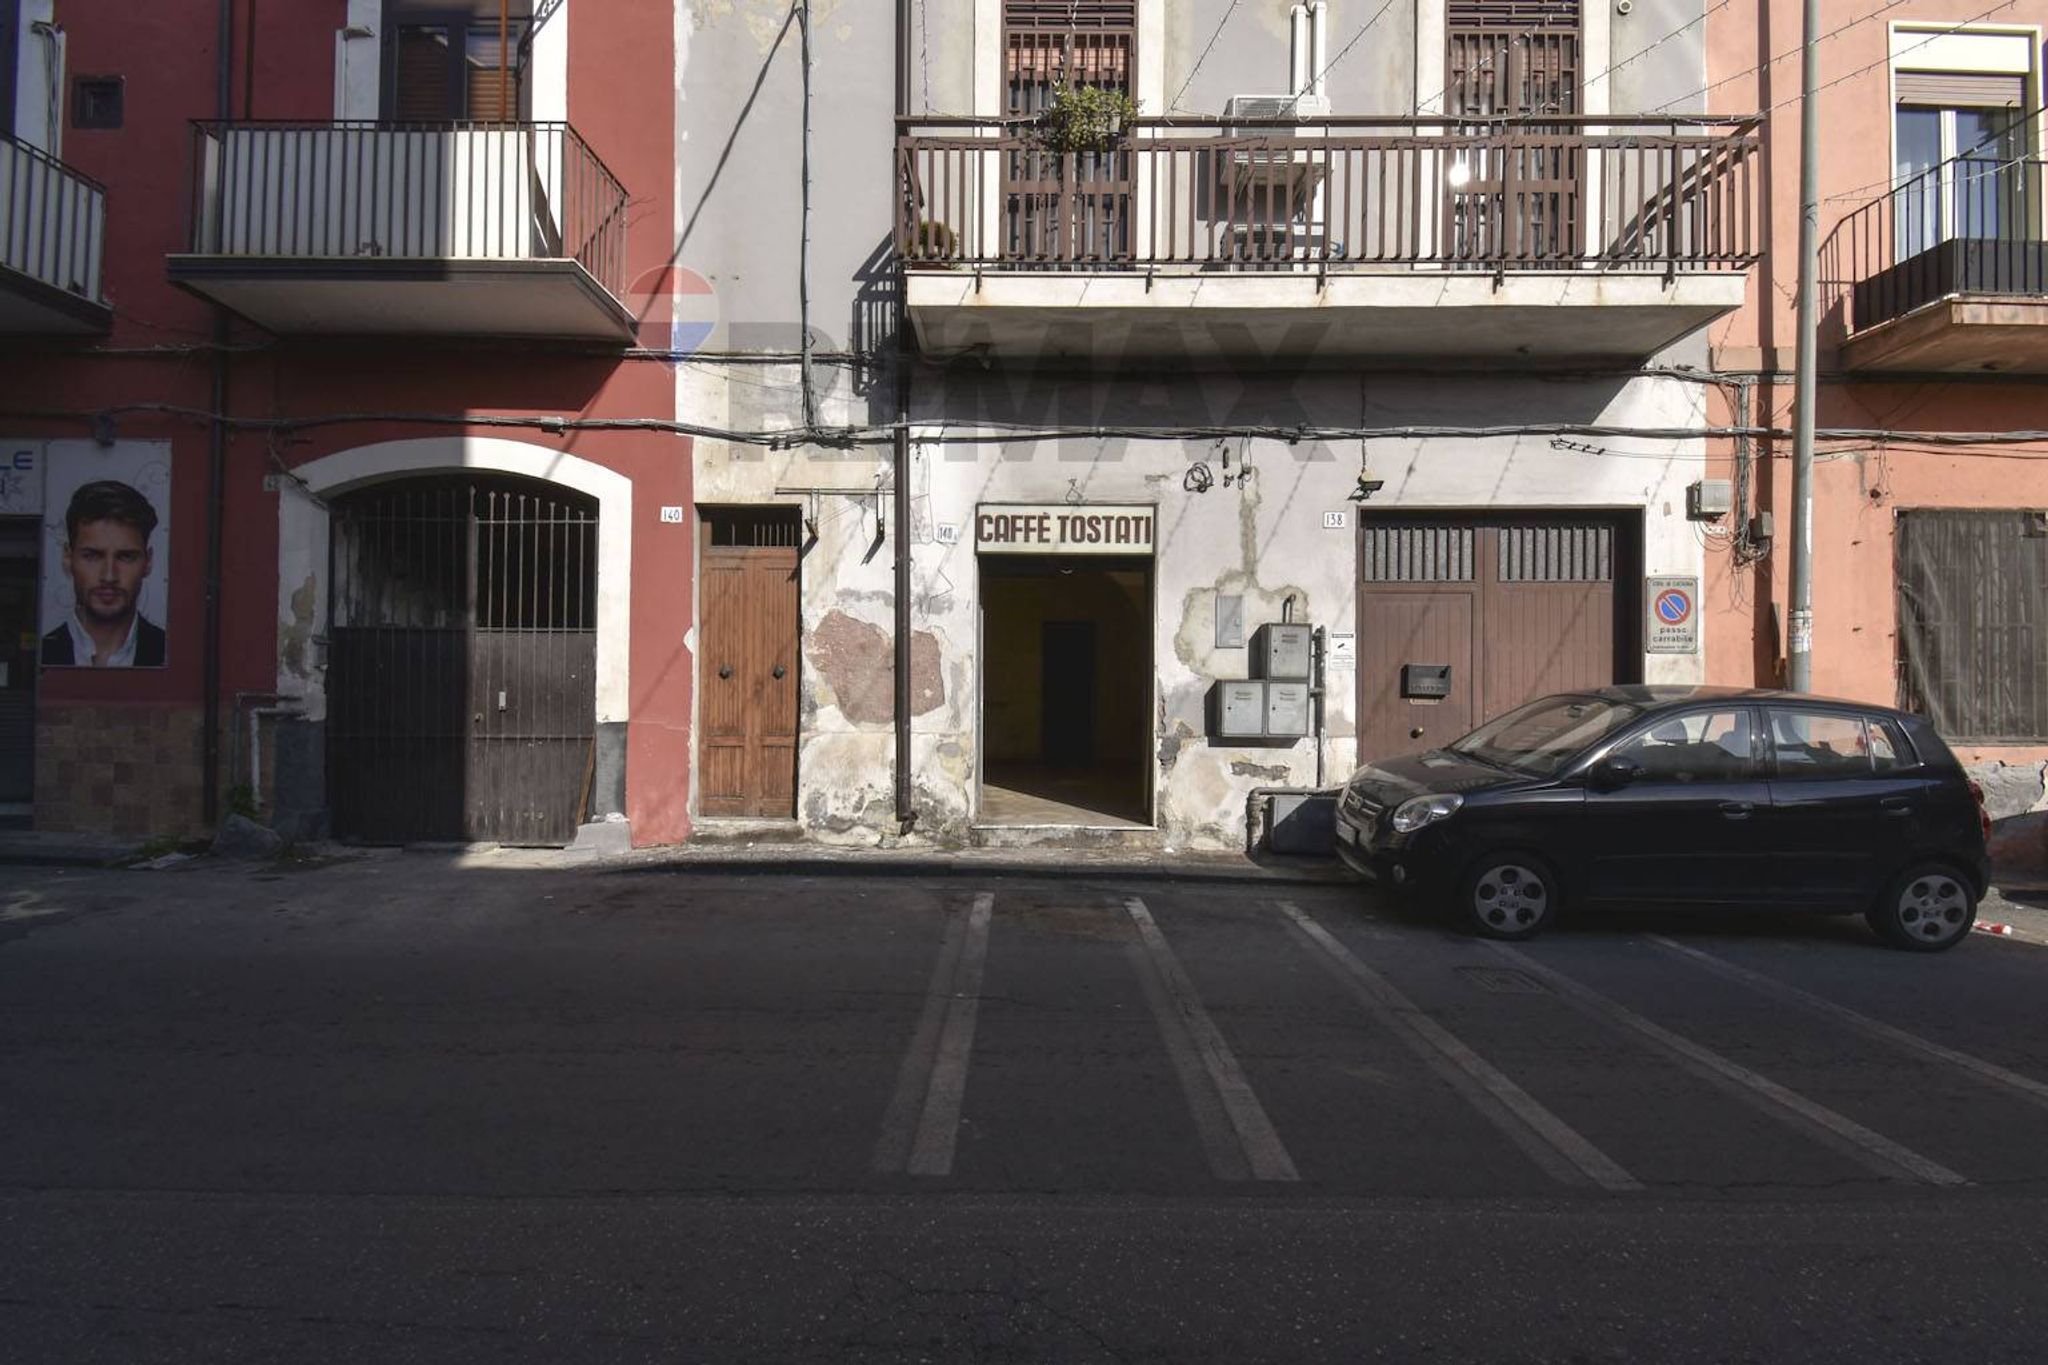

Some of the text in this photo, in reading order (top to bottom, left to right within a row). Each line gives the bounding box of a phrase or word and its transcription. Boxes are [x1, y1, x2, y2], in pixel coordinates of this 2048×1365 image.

[664, 509, 680, 521] 140
[1326, 513, 1343, 526] 138
[977, 512, 1152, 544] CAFFÈ TOSTATI
[1653, 635, 1693, 643] carrabile
